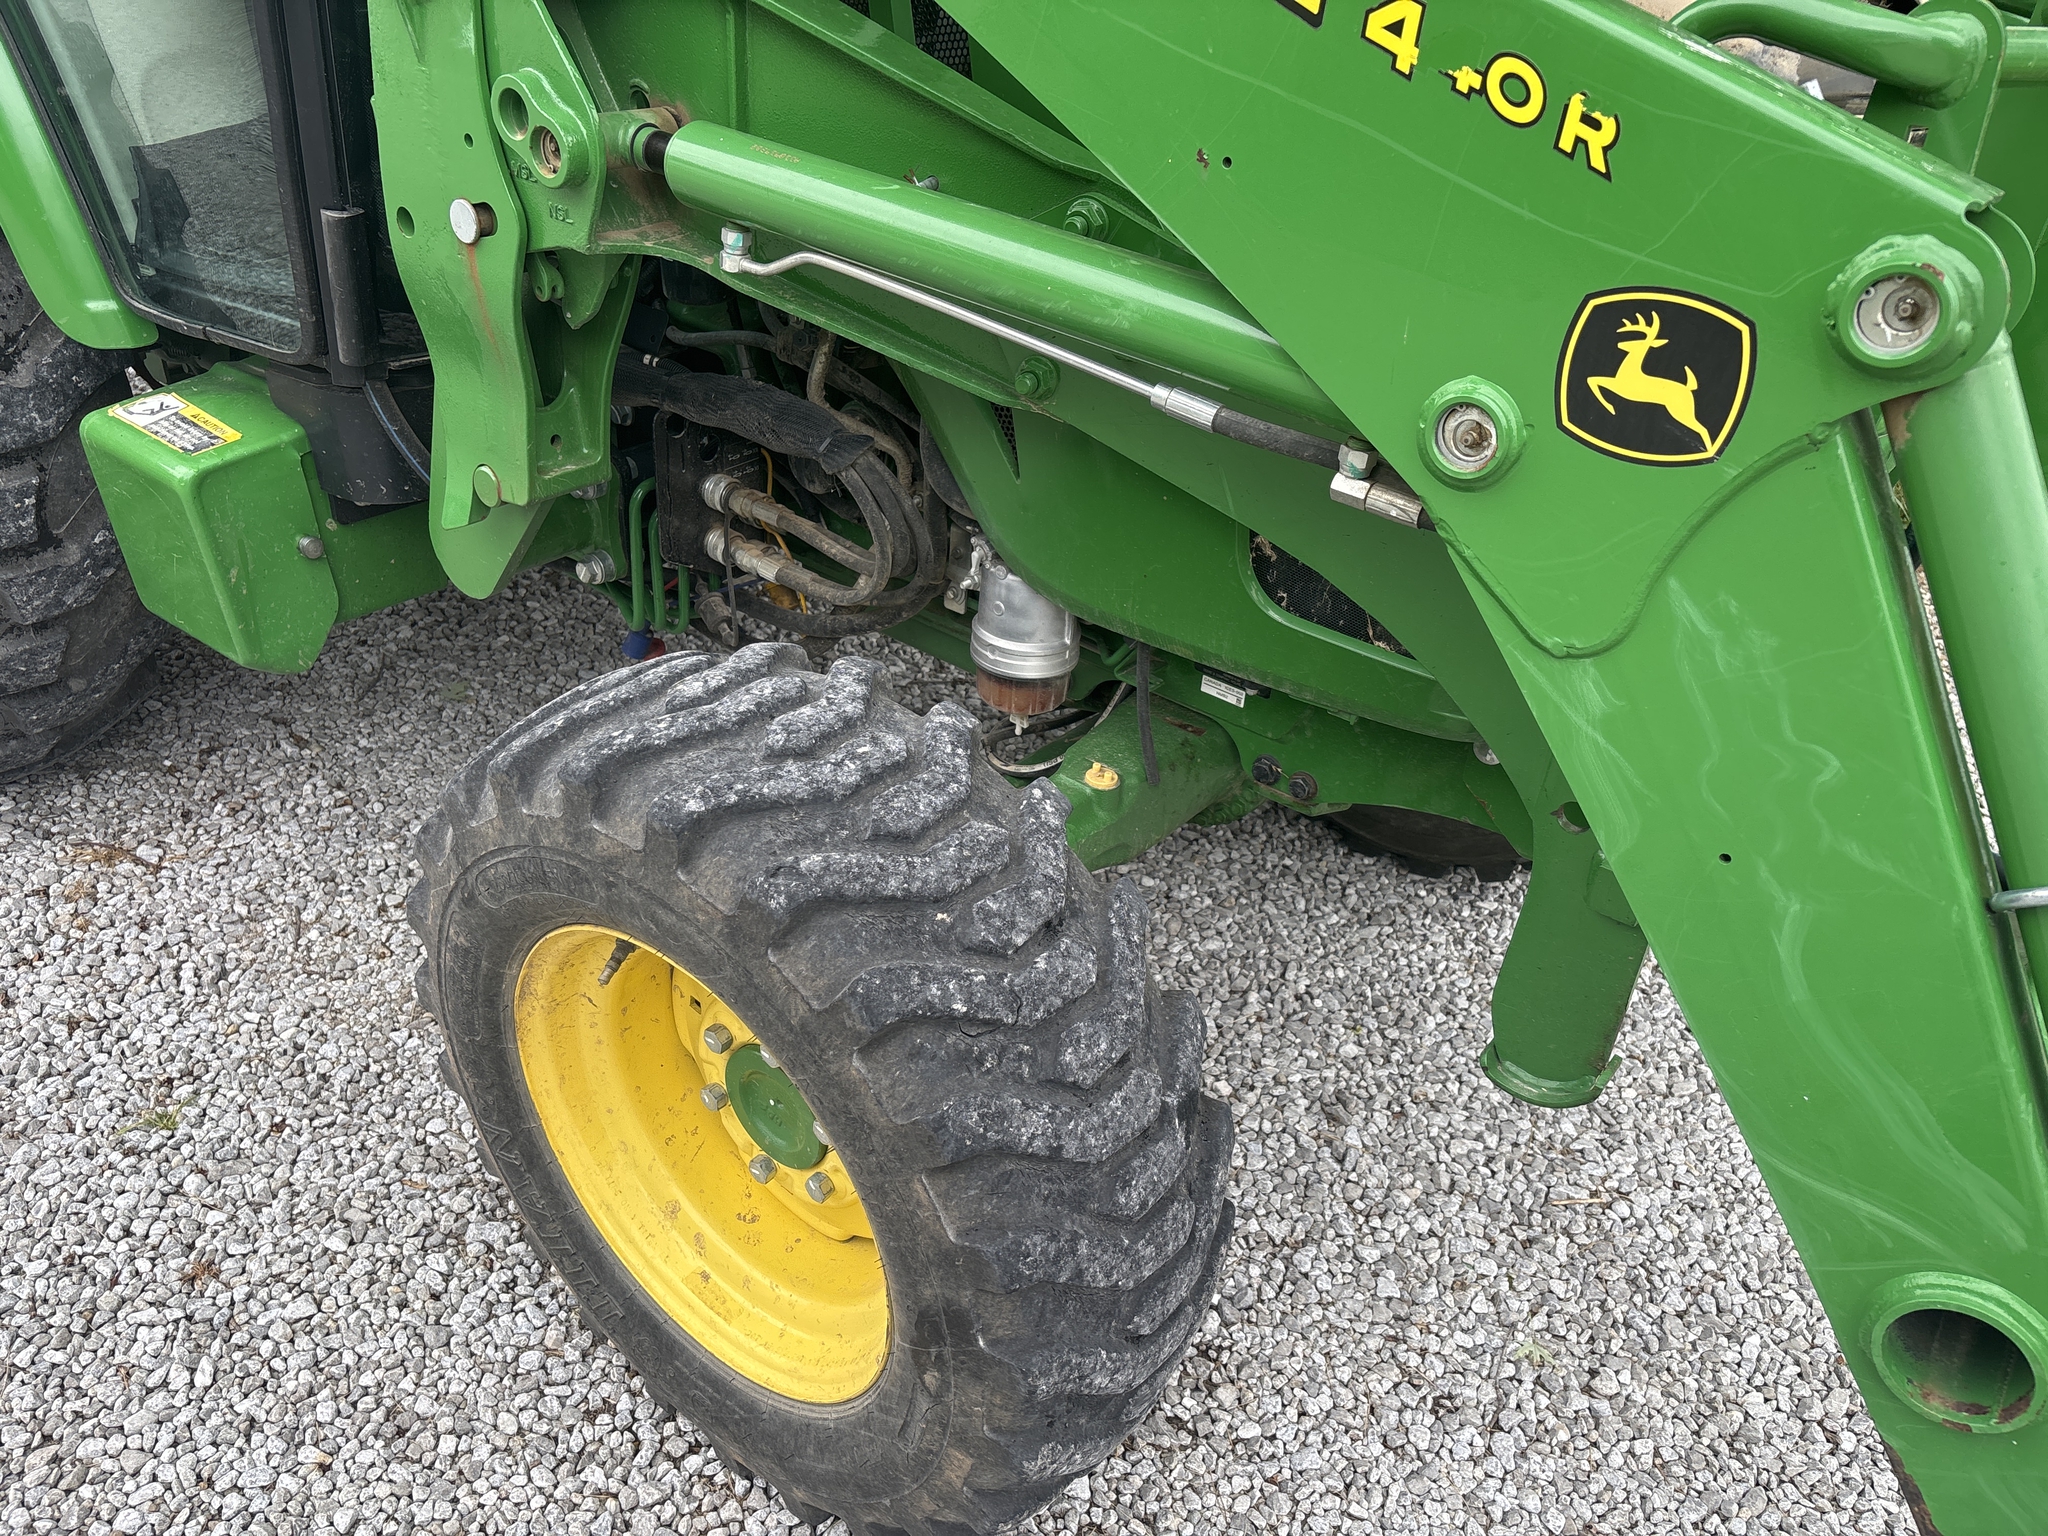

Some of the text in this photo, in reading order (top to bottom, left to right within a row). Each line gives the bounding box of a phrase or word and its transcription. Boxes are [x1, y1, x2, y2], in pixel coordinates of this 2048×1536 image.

[548, 200, 574, 224] NSL
[197, 416, 229, 436] CAUTION
[1203, 677, 1222, 688] CANADA
